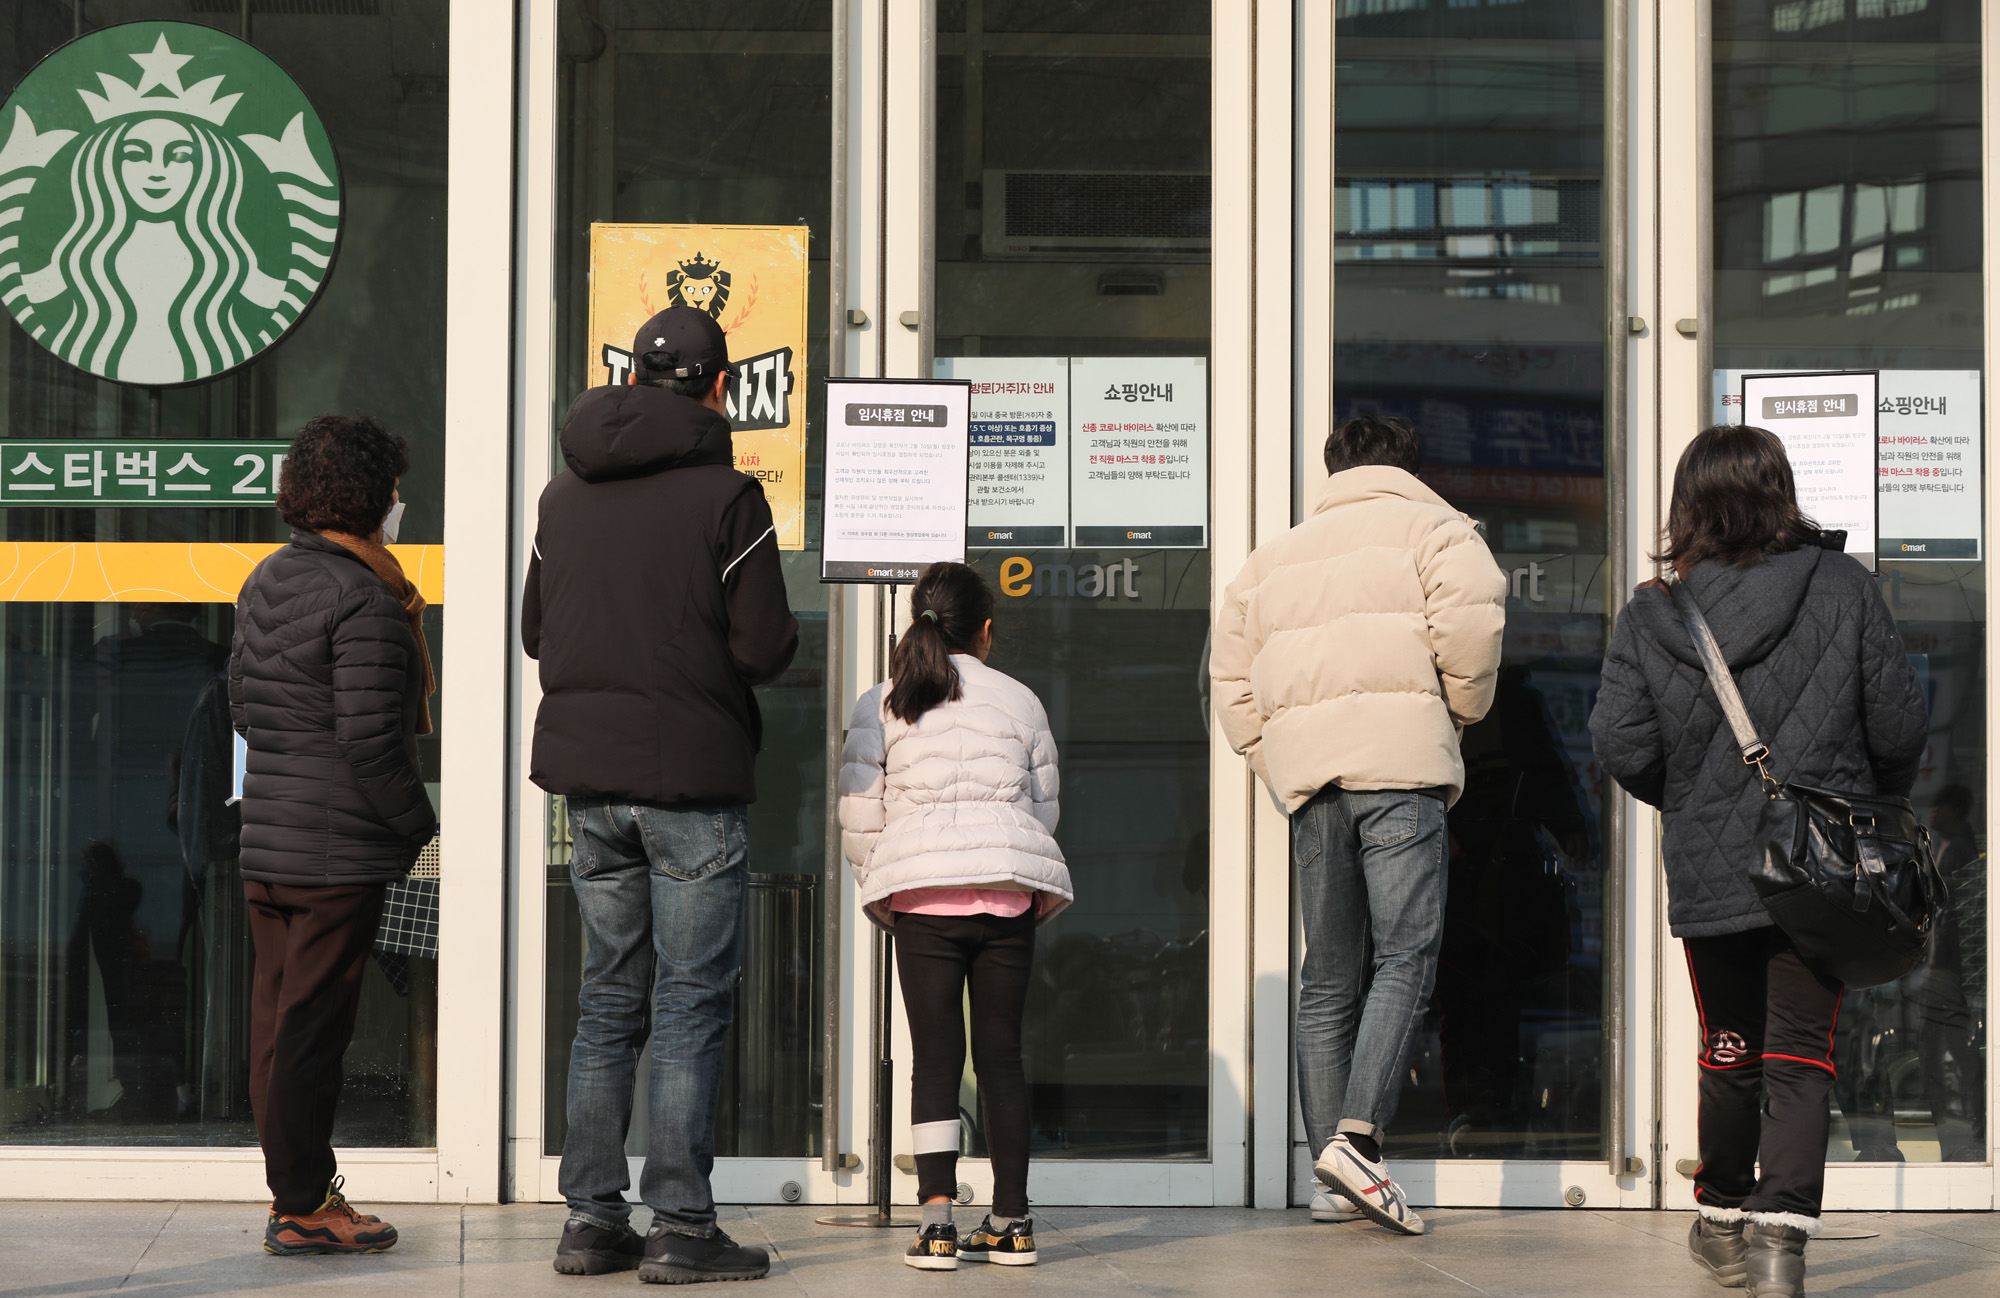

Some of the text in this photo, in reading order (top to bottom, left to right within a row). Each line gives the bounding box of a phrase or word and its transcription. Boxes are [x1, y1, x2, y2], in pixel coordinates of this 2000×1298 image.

[971, 382, 1054, 395] 방문[거주]자 안내
[1104, 383, 1173, 402] 쇼핑안내
[1774, 399, 1846, 414] 임시휴점 안내
[1879, 396, 1946, 415] 쇼핑안내
[858, 408, 934, 423] 임시휴점 안내
[1082, 423, 1196, 432] 신종 코로나 바이러스 확산에 따라
[1090, 439, 1187, 448] 고객님과 직원의 안전을 위해
[1898, 436, 1928, 445] 바이러스
[1930, 436, 1952, 445] 확산에
[1955, 436, 1970, 445] 따라
[740, 453, 760, 466] 사자
[1089, 455, 1189, 464] 전 직원 마스크 착용 중입니다
[1897, 452, 1919, 460] 직원의
[1921, 452, 1943, 460] 안전을
[1946, 452, 1961, 460] 위해
[9, 450, 211, 496] 스타벅스
[1088, 471, 1190, 480] 고객님들의 양해 부탁드립니다
[1891, 468, 1913, 476] 마스크
[1915, 468, 1930, 476] 착용
[1902, 484, 1917, 492] 양해
[1919, 484, 1964, 492] 부탁드립니다
[988, 531, 1013, 540] emart
[1127, 531, 1152, 540] emart
[868, 568, 918, 578] emart 성수점
[1000, 556, 1139, 597] emart
[929, 1240, 954, 1254] VANS
